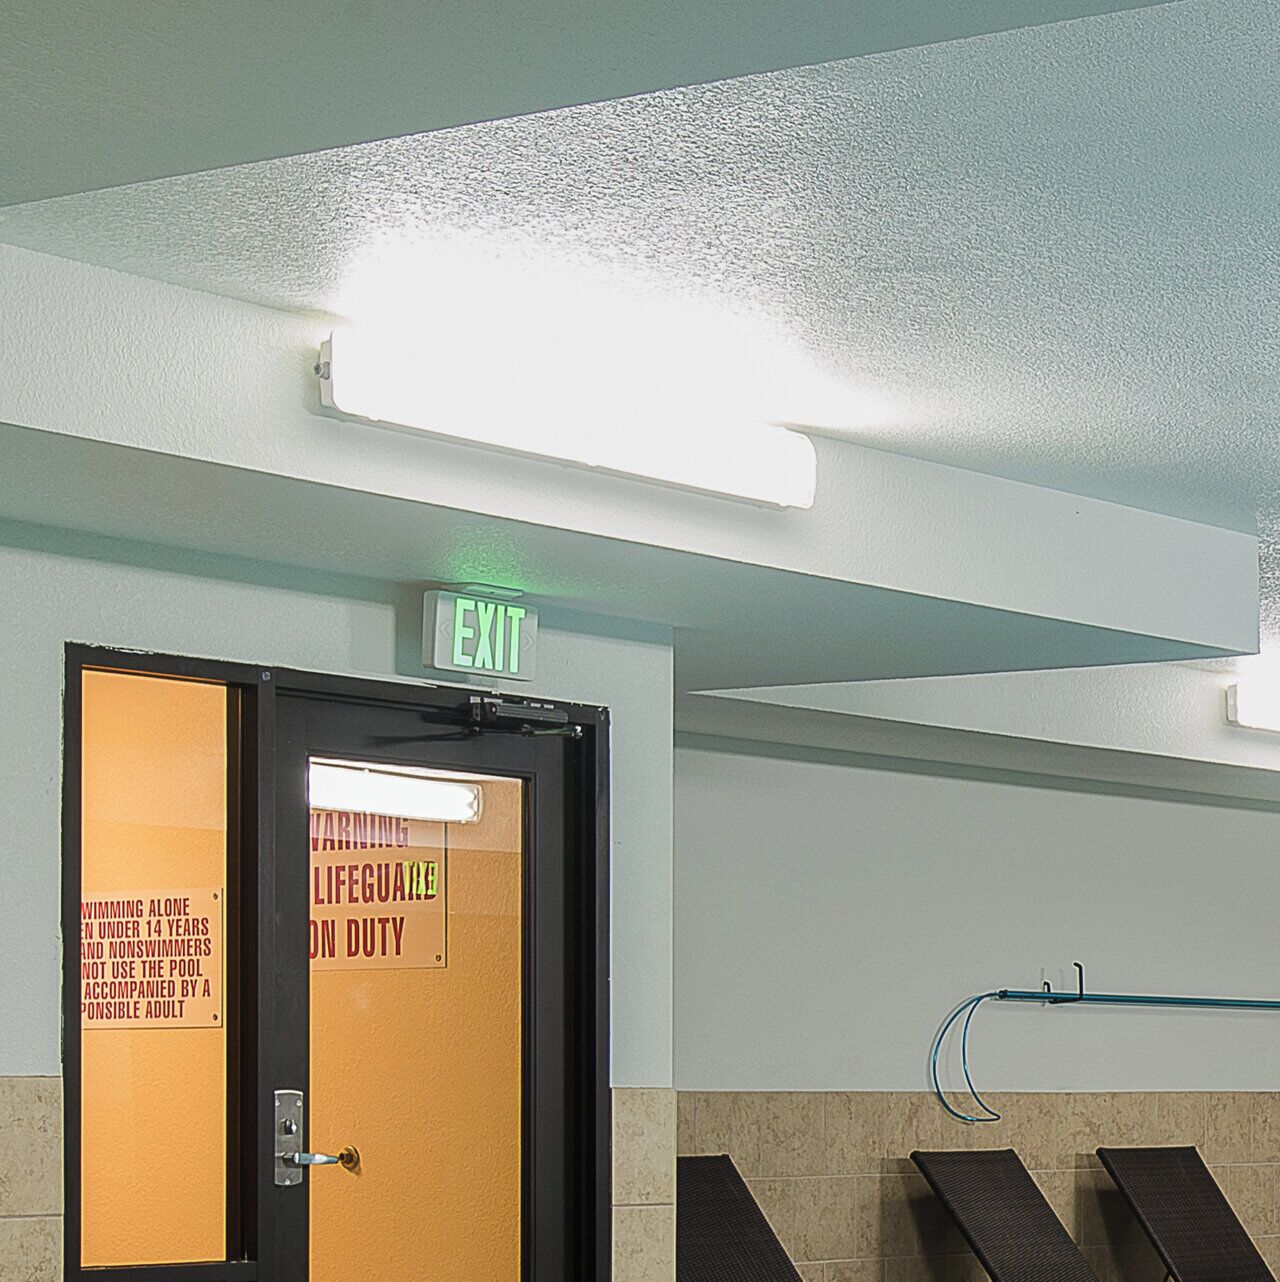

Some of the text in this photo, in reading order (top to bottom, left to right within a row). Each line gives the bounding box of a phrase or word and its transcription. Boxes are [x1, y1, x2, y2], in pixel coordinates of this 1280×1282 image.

[453, 598, 526, 674] EXIT
[148, 897, 190, 918] ALONE
[98, 920, 140, 940] UNDER
[145, 919, 162, 938] 14
[167, 917, 209, 937] YEARS
[310, 916, 405, 959] ON DUTY
[109, 938, 212, 959] NONSWIMMERS
[82, 958, 203, 980] NOT USE THE POOL
[84, 978, 211, 1000] ACCOMPANIED BY A
[145, 999, 185, 1019] ADULT
